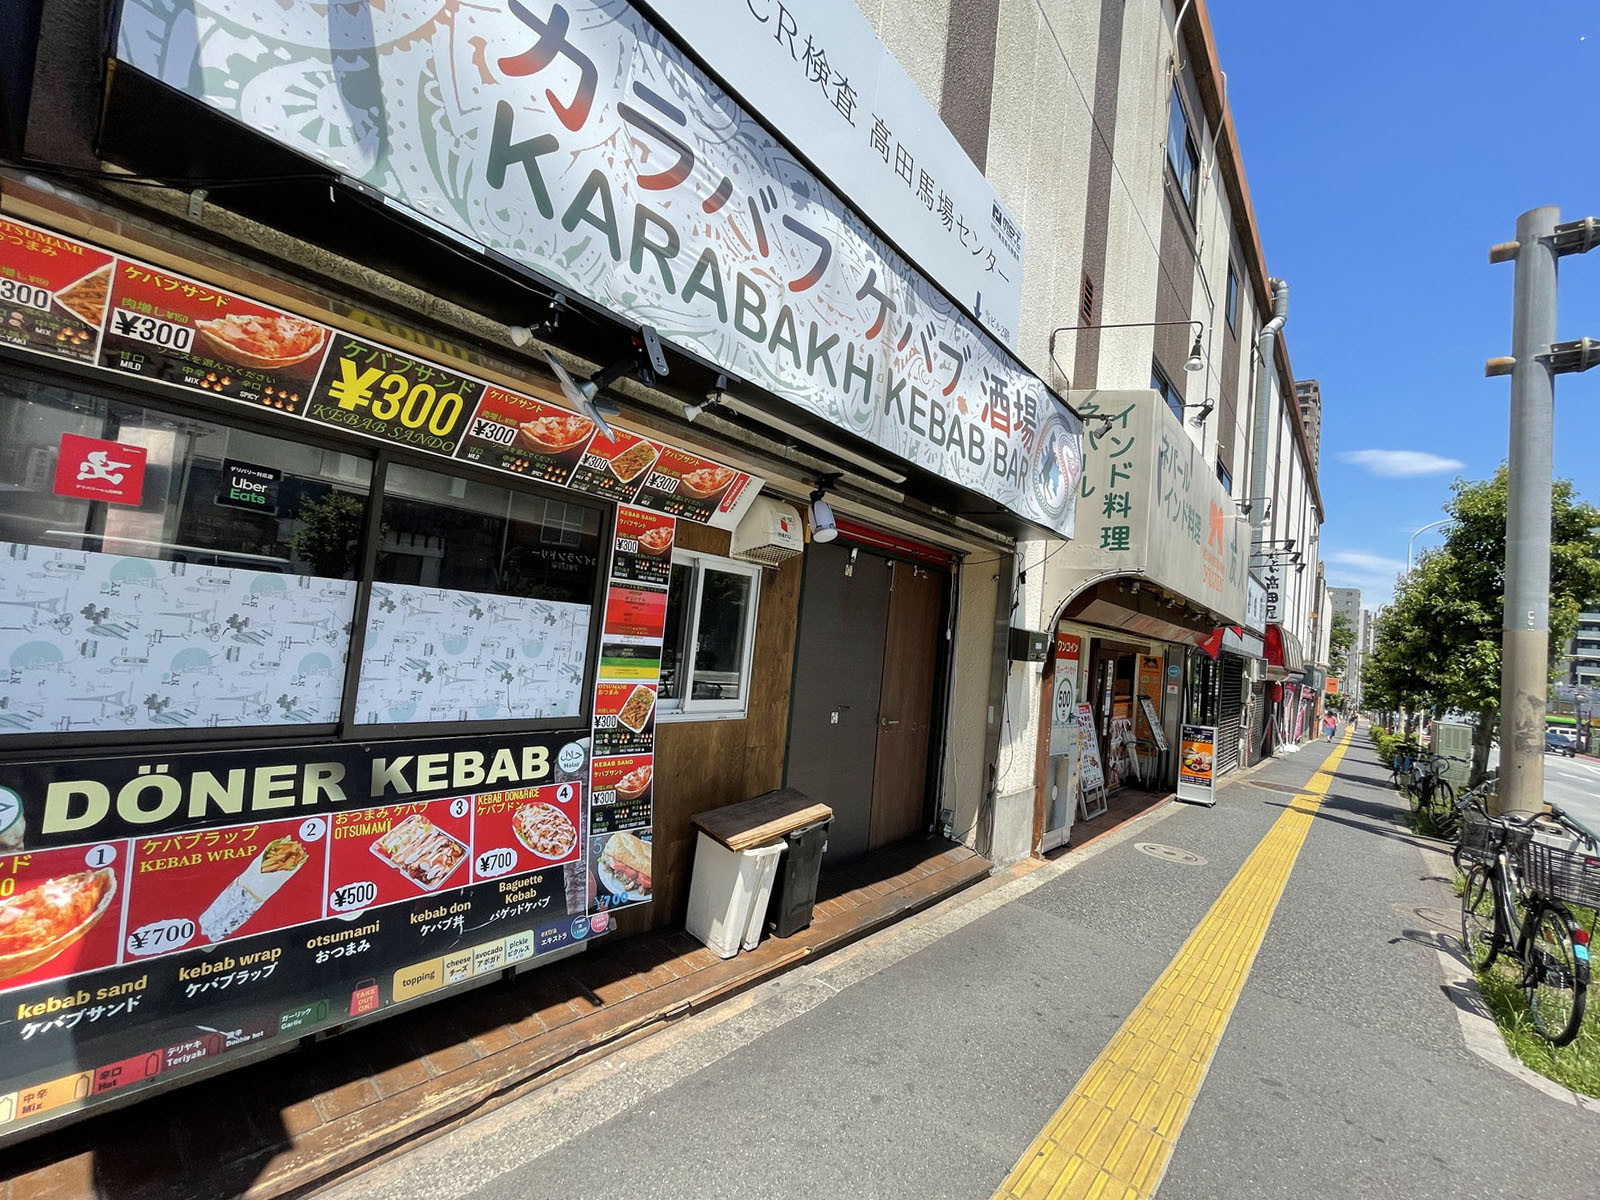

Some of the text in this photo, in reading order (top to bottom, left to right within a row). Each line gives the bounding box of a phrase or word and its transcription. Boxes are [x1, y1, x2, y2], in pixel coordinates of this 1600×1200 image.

[870, 112, 1009, 283] 高田馬場センター
[0, 278, 49, 310] 300
[124, 265, 231, 308] ケバブサンド
[486, 99, 873, 404] KARABAKH
[885, 368, 985, 467] KEBAB
[993, 436, 1029, 494] BAR
[115, 309, 190, 350] ¥300
[119, 359, 142, 372] MILD
[120, 351, 145, 363] 甘口
[857, 272, 972, 393] ケバブ
[980, 367, 1037, 446] 酒場
[343, 340, 476, 396] ケバブサンド
[184, 375, 200, 386] MIX
[328, 357, 464, 437] ¥300
[489, 388, 544, 414] ケバブサンド
[312, 402, 456, 453] KEBAB SANDO
[473, 419, 515, 445] ¥300
[579, 452, 609, 472] ¥300
[232, 476, 268, 493] Uber
[649, 472, 681, 493] ¥300
[1099, 402, 1137, 552] インド料理
[229, 487, 266, 505] Eats
[617, 539, 638, 553] ¥300
[1058, 689, 1071, 709] 500
[594, 715, 617, 728] ¥300
[594, 760, 616, 768] KEBAB
[42, 746, 550, 834] DÖNER KEBAB
[477, 792, 502, 805] KEBAB
[559, 784, 568, 800] 4
[593, 791, 615, 805] ¥300
[335, 802, 429, 825] おつまみ ケバブ
[455, 799, 463, 815] 3
[305, 822, 317, 838] 2
[142, 826, 259, 856] ケバブラップ
[592, 837, 603, 854] 5
[95, 848, 106, 866] 1
[140, 845, 258, 873] KEBAB WRAP
[480, 853, 513, 872] ¥700
[499, 874, 543, 893] Baguette
[334, 883, 375, 908] ¥500
[505, 888, 537, 905] Kebab
[410, 901, 472, 924] kebab don
[306, 919, 381, 949] otsumami
[420, 915, 465, 937] ケバブ丼
[540, 928, 558, 938] extra
[131, 922, 194, 949] ¥700
[509, 937, 529, 950] pickle
[541, 932, 568, 946] エキストラ
[315, 943, 371, 964] おつまみ
[475, 945, 504, 960] avocado
[179, 947, 282, 982] kebab wrap
[446, 955, 472, 969] cheese
[185, 961, 279, 998] ケバブラップ
[402, 970, 436, 988] topping
[449, 965, 469, 978] チーズ
[17, 974, 148, 1021] kebab sand
[356, 988, 376, 999] TAKE
[358, 995, 374, 1006] OUT
[20, 994, 143, 1041] ケバブサンド
[281, 1007, 312, 1023] ガーリック
[280, 1019, 303, 1030] Garlic
[252, 1030, 264, 1039] hot
[166, 1047, 207, 1067] Teriyaki
[167, 1039, 203, 1057] テリヤキ
[100, 1066, 122, 1080] 辛口
[98, 1080, 118, 1092] Hot
[23, 1088, 49, 1104] 中辛
[22, 1101, 43, 1115] Mix
